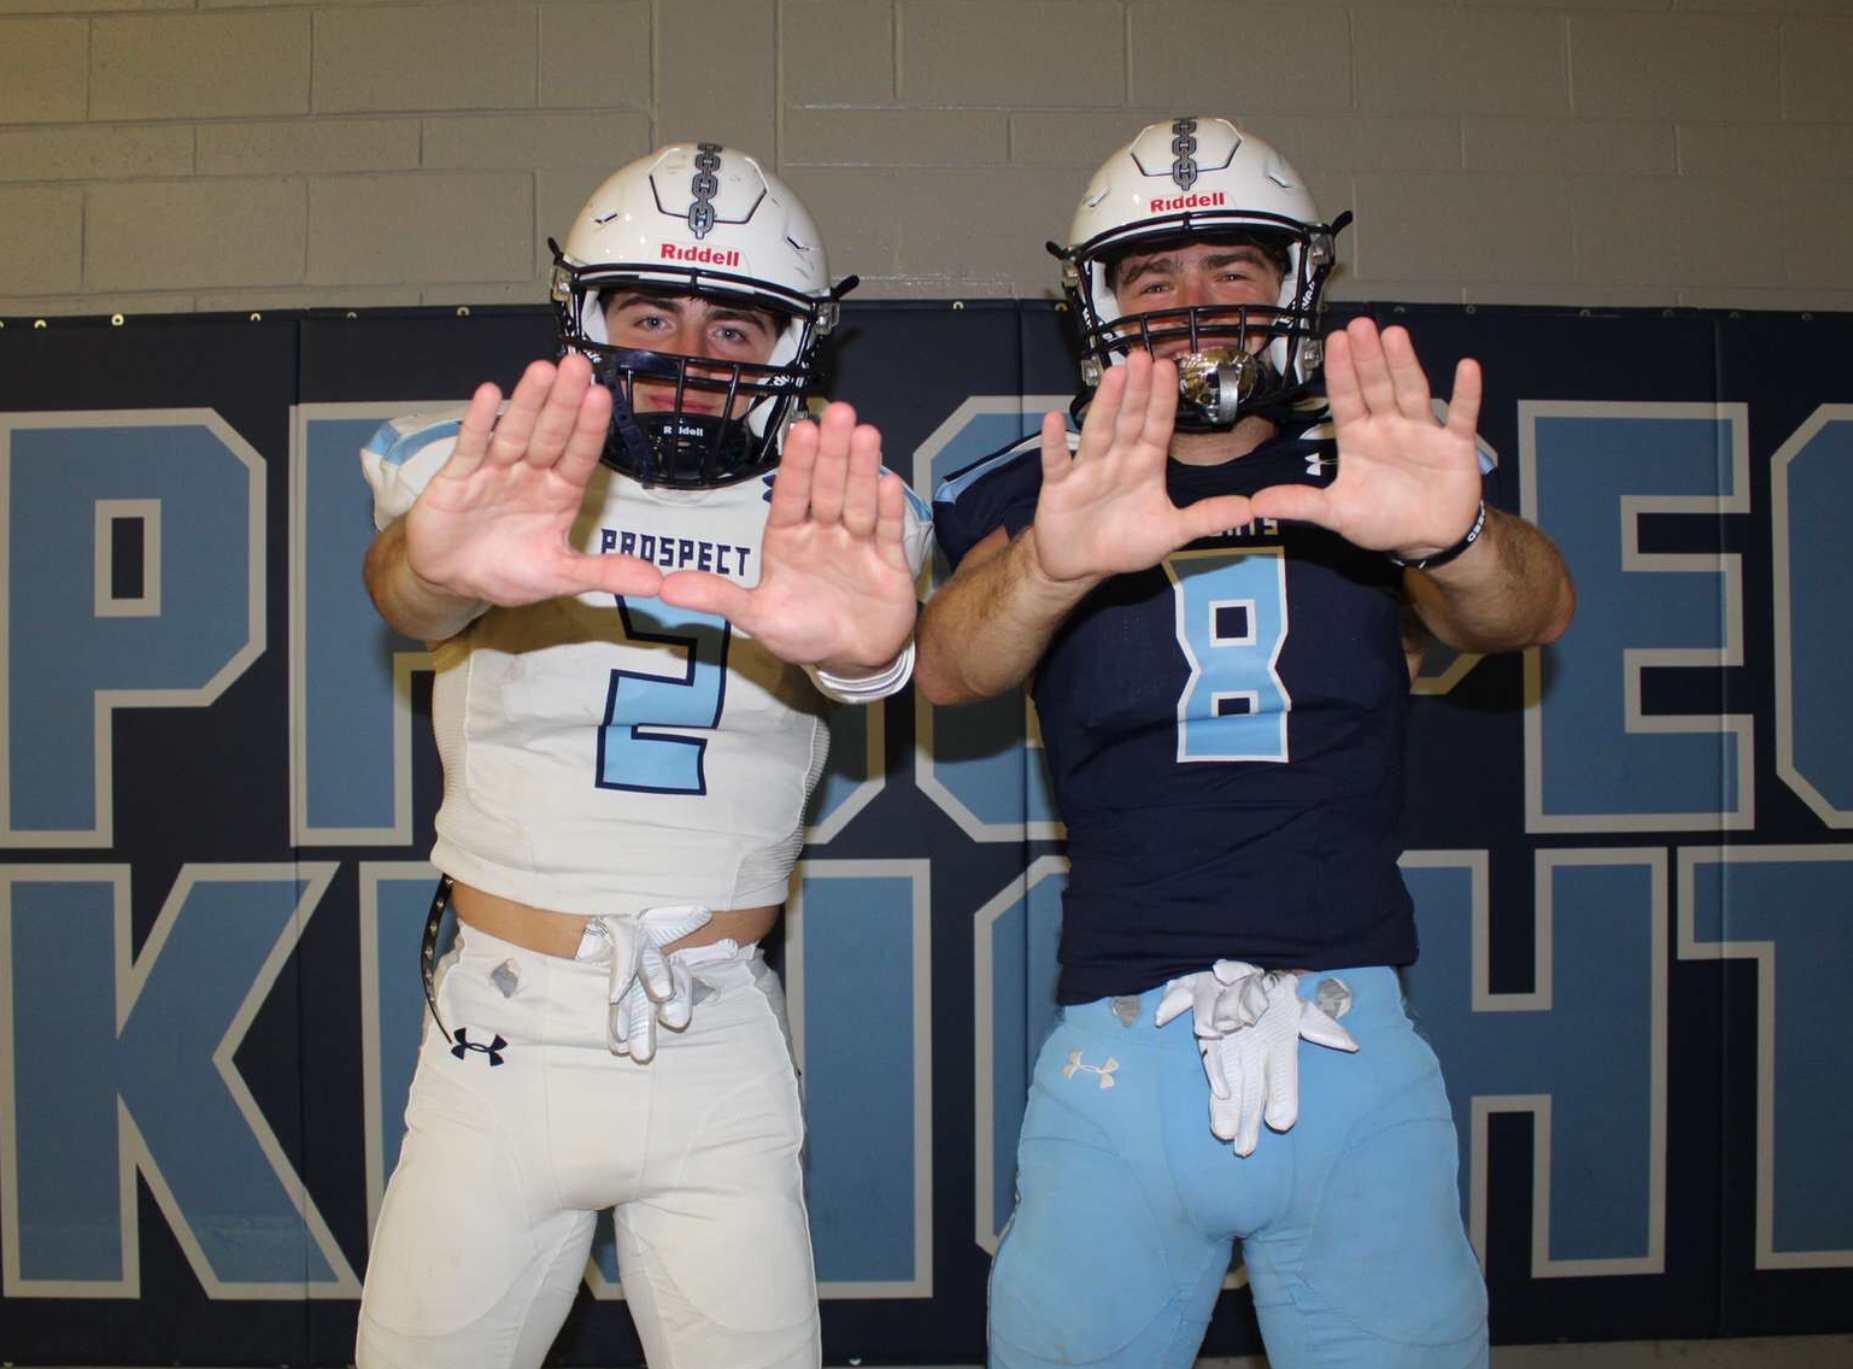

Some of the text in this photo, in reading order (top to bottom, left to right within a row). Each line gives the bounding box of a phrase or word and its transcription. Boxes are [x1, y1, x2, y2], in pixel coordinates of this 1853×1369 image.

[1150, 192, 1225, 213] Riddell
[660, 243, 739, 267] Riddell
[601, 528, 751, 576] PROSPECT
[1160, 546, 1292, 764] 8
[595, 592, 732, 796] 2
